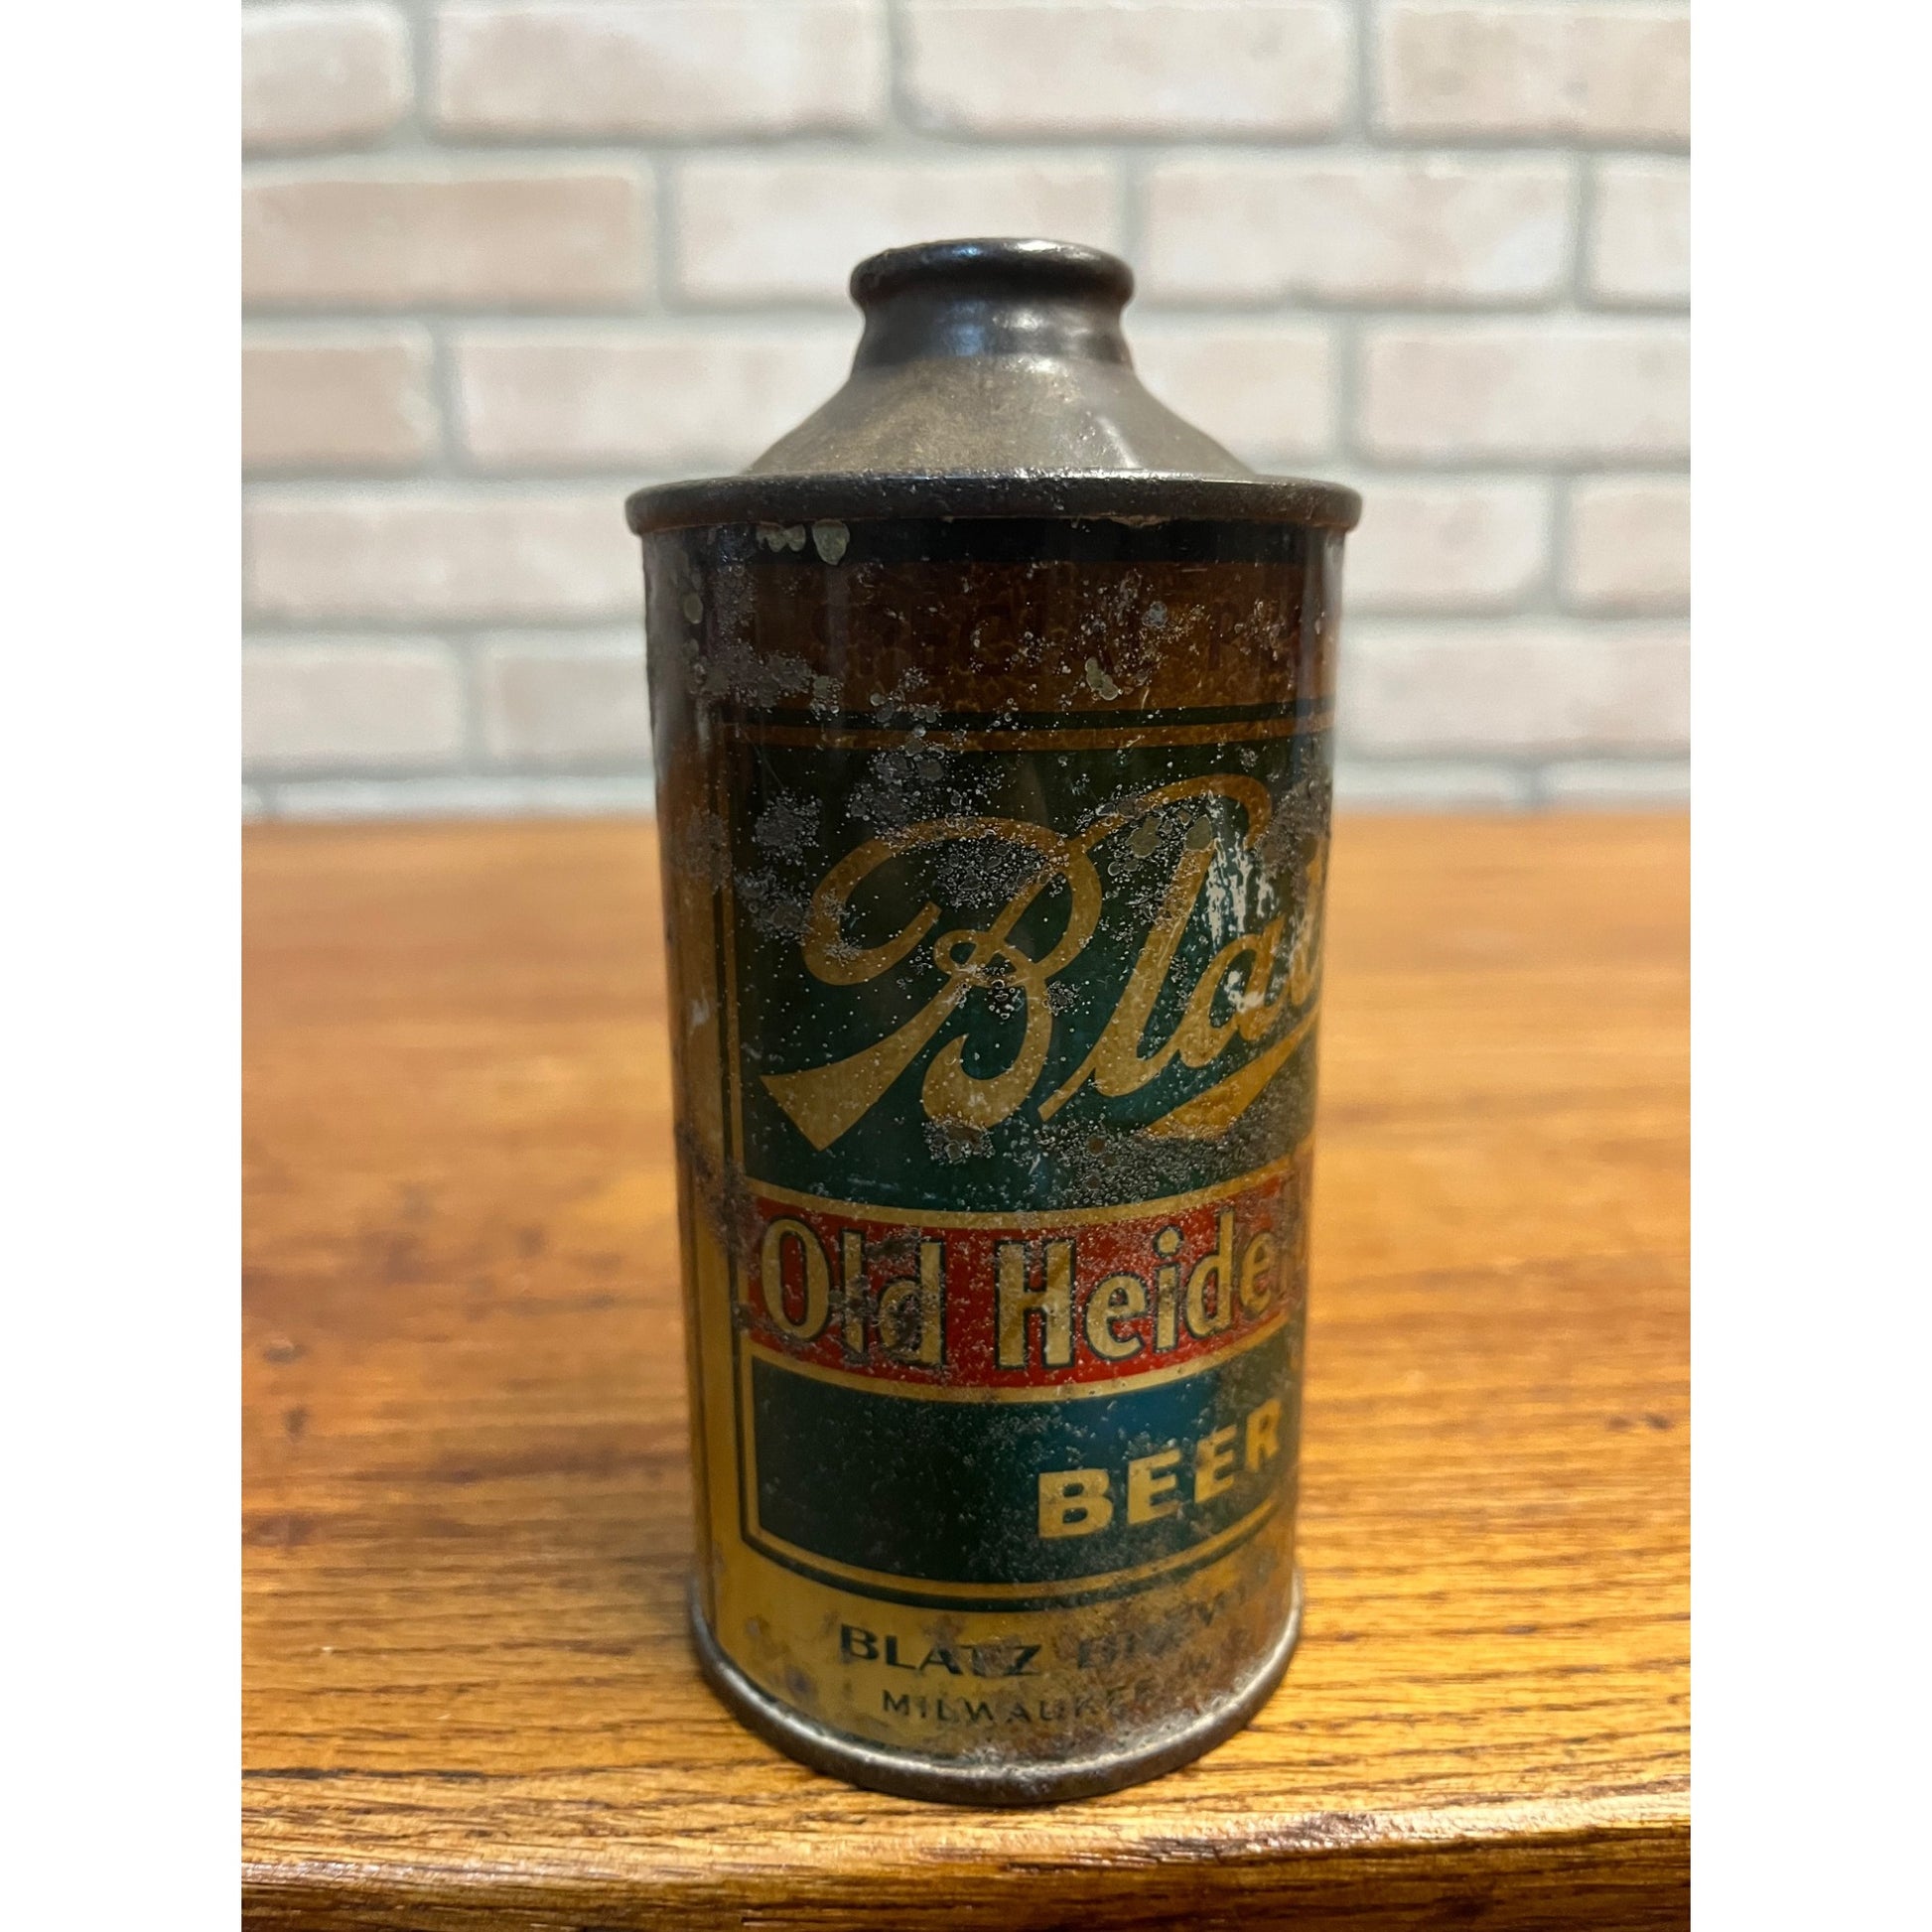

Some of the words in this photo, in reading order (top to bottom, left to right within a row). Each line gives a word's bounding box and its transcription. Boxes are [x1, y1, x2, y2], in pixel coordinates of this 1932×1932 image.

[759, 1216, 945, 1367] Old
[997, 1206, 1283, 1370] Heide
[1037, 1398, 1282, 1540] BEER
